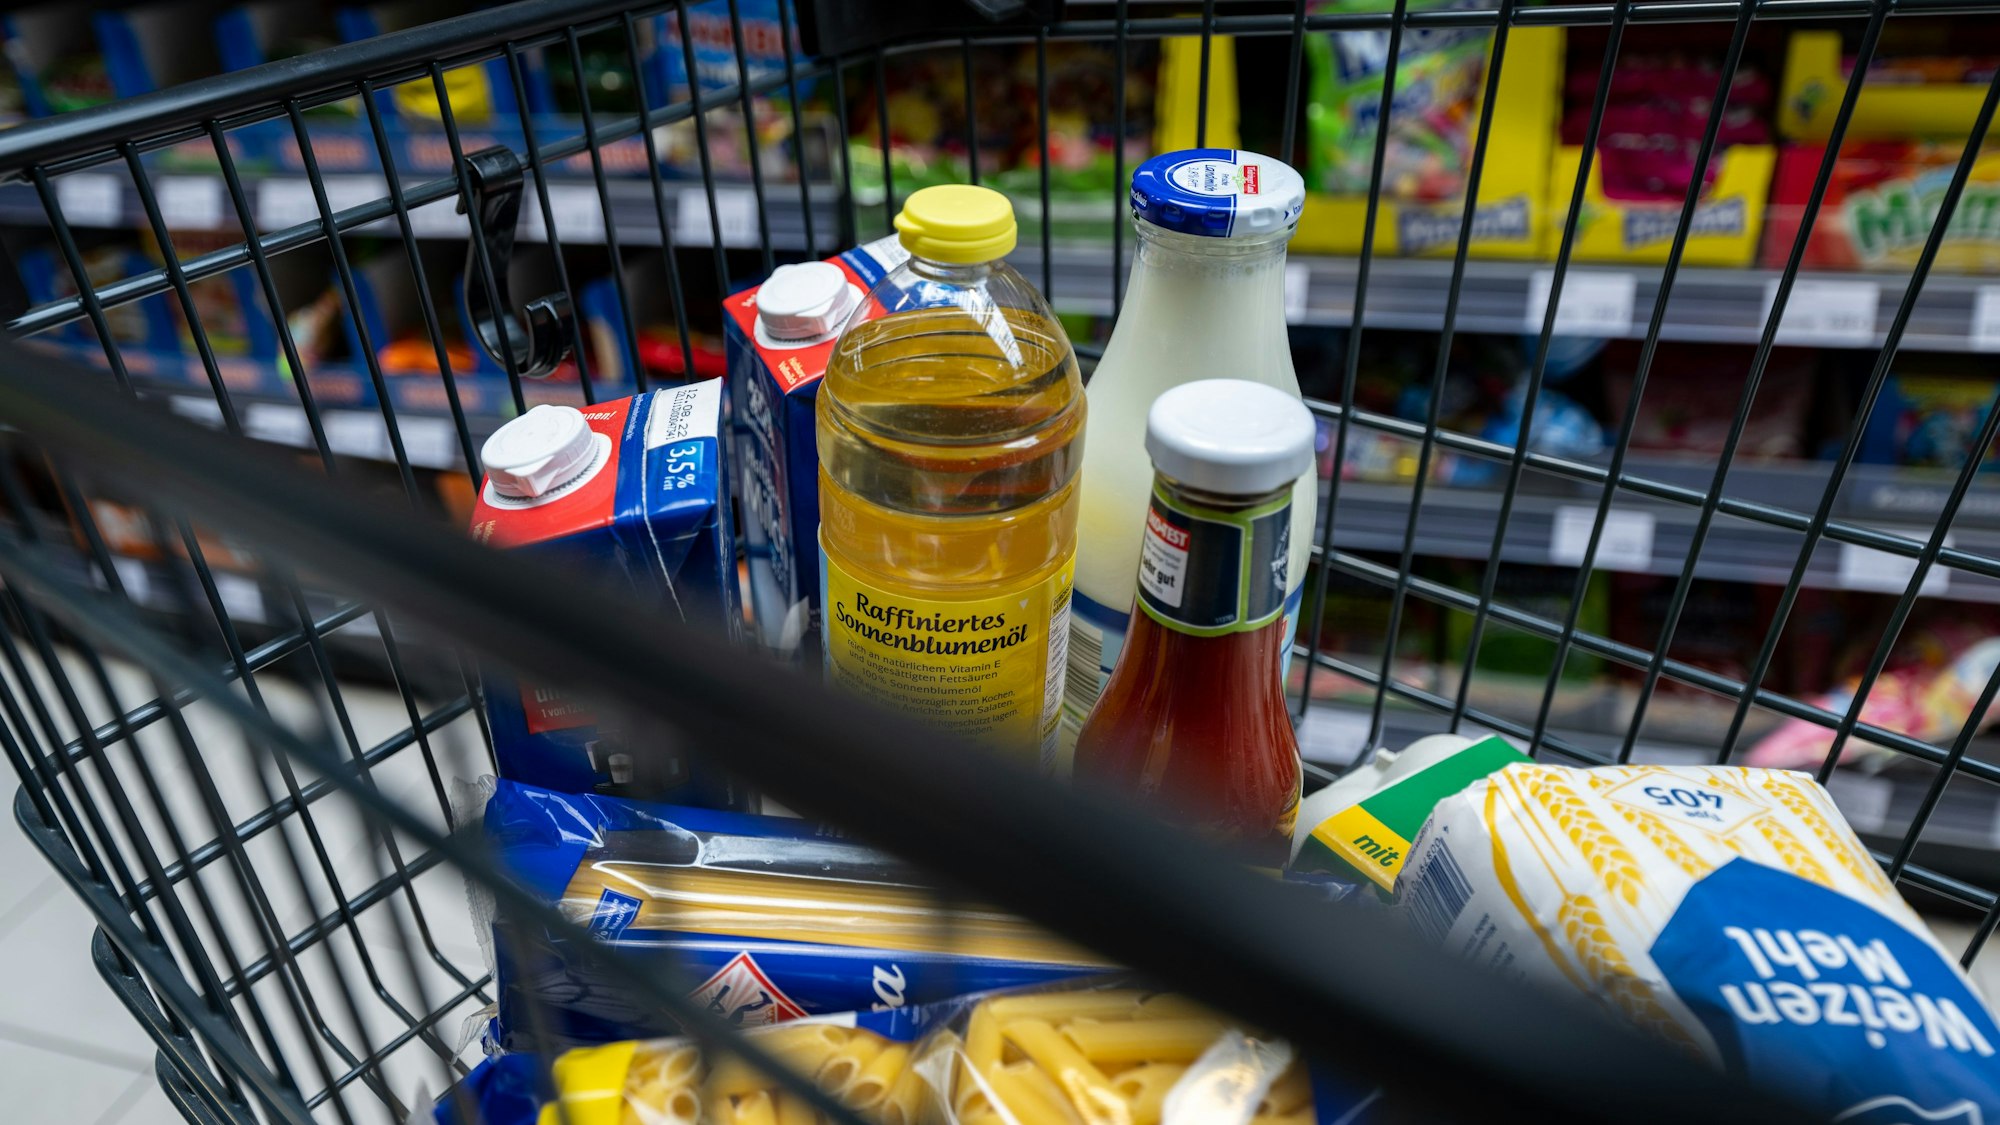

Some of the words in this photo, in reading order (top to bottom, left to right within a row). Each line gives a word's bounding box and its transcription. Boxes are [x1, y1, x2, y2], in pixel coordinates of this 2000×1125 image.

[677, 388, 698, 438] 12.08.22
[666, 445, 697, 489] 3,5%
[1157, 570, 1175, 588] gut
[836, 601, 1028, 655] Sonnenblumenöl
[856, 592, 1005, 633] Raffiniertes
[847, 637, 867, 654] reich
[868, 650, 880, 661] an
[883, 656, 946, 673] natürlichem
[949, 662, 991, 674] Vitamin
[994, 659, 1001, 669] E
[849, 650, 865, 664] und
[866, 659, 936, 683] ungesättigten
[939, 670, 998, 684] Fettsäuren
[890, 678, 982, 696] Sonnenblumenöl
[910, 693, 957, 709] vorzüglich
[959, 698, 979, 707] zum
[982, 689, 1016, 705] Kochen,
[541, 708, 547, 718] 1
[547, 707, 566, 718] von
[902, 702, 952, 716] Anrichten
[955, 707, 974, 716] von
[1644, 786, 1722, 809] 405
[1685, 810, 1724, 822] Type
[1352, 834, 1399, 867] mit
[1723, 925, 1912, 988] Mehl
[1719, 981, 1995, 1057] Weizen
